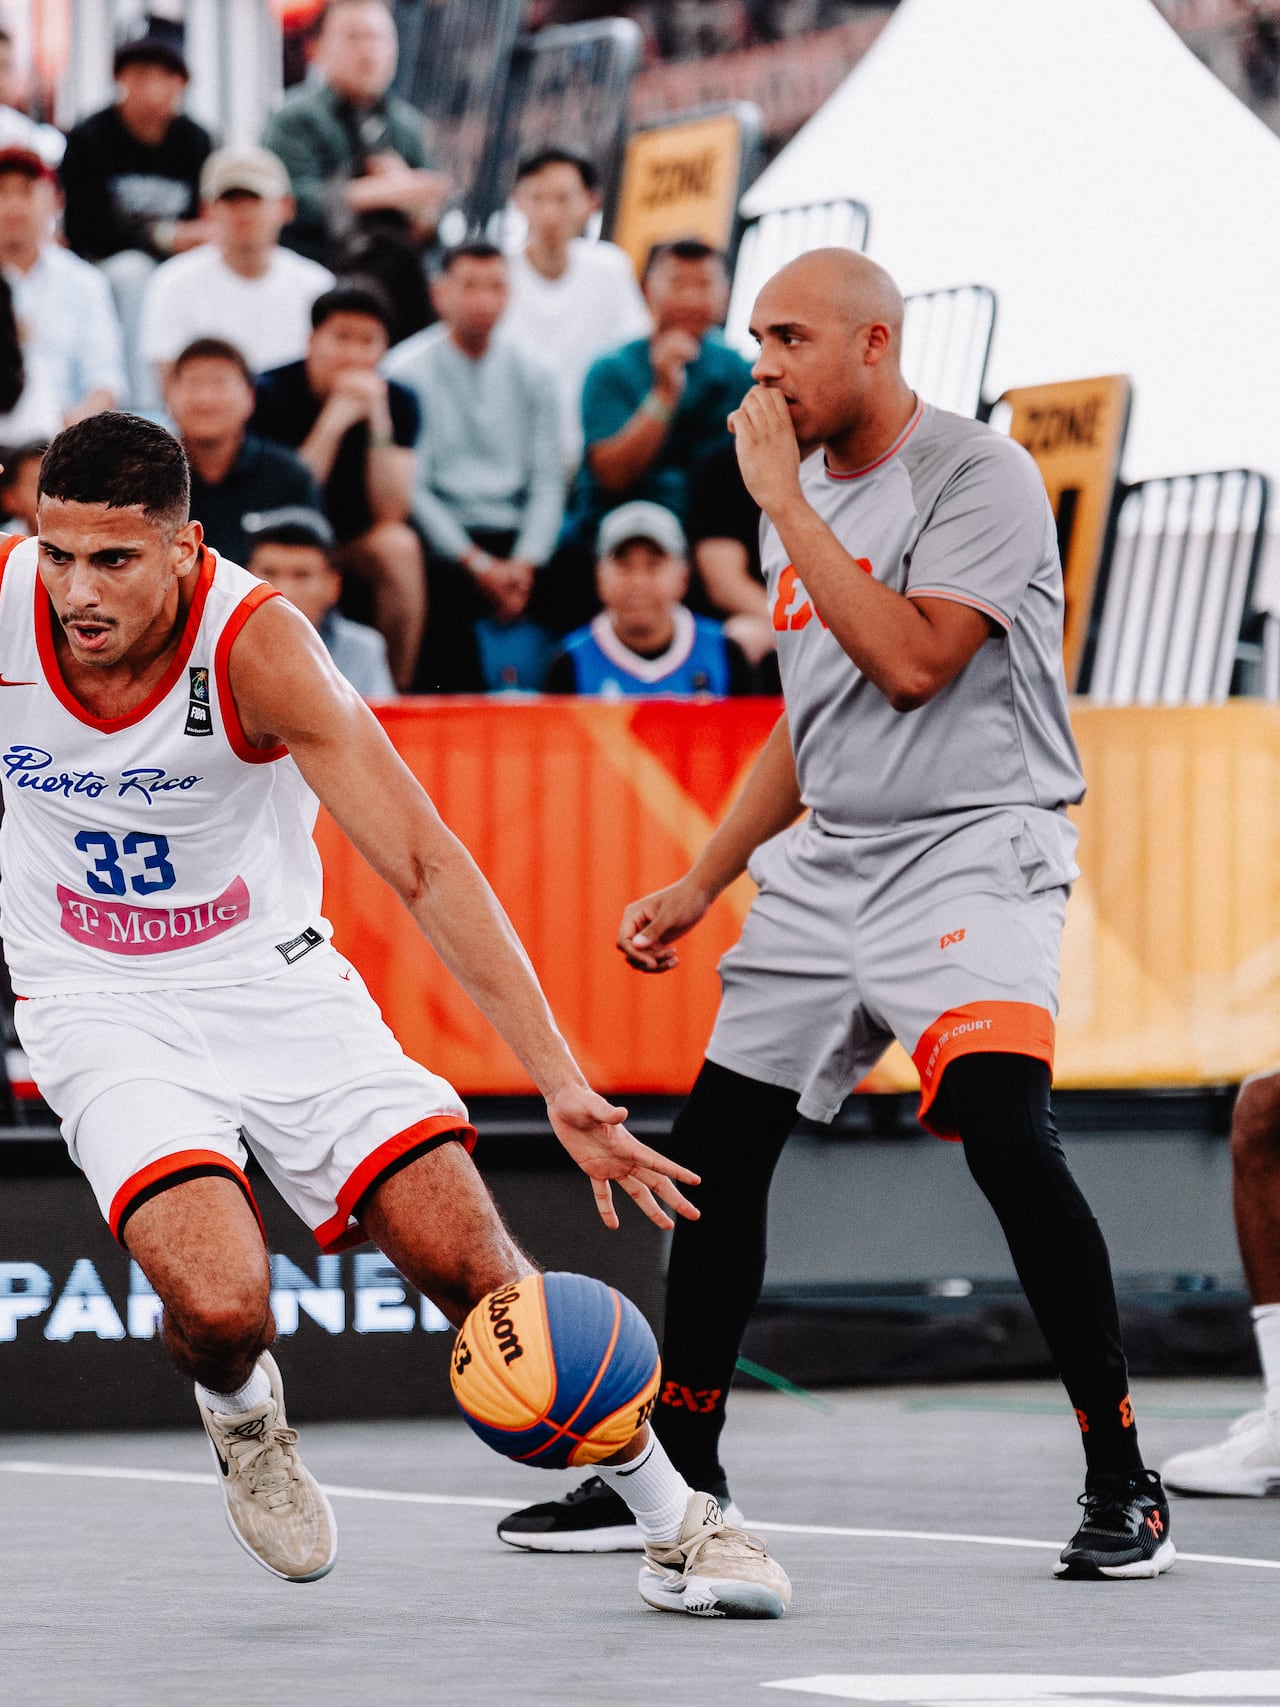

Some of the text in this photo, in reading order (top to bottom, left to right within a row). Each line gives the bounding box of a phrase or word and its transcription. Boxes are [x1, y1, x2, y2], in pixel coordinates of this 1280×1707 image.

[2, 745, 204, 805] Puerto Rico
[74, 830, 177, 896] 33
[952, 1019, 993, 1037] COURT
[489, 1283, 525, 1367] ilson
